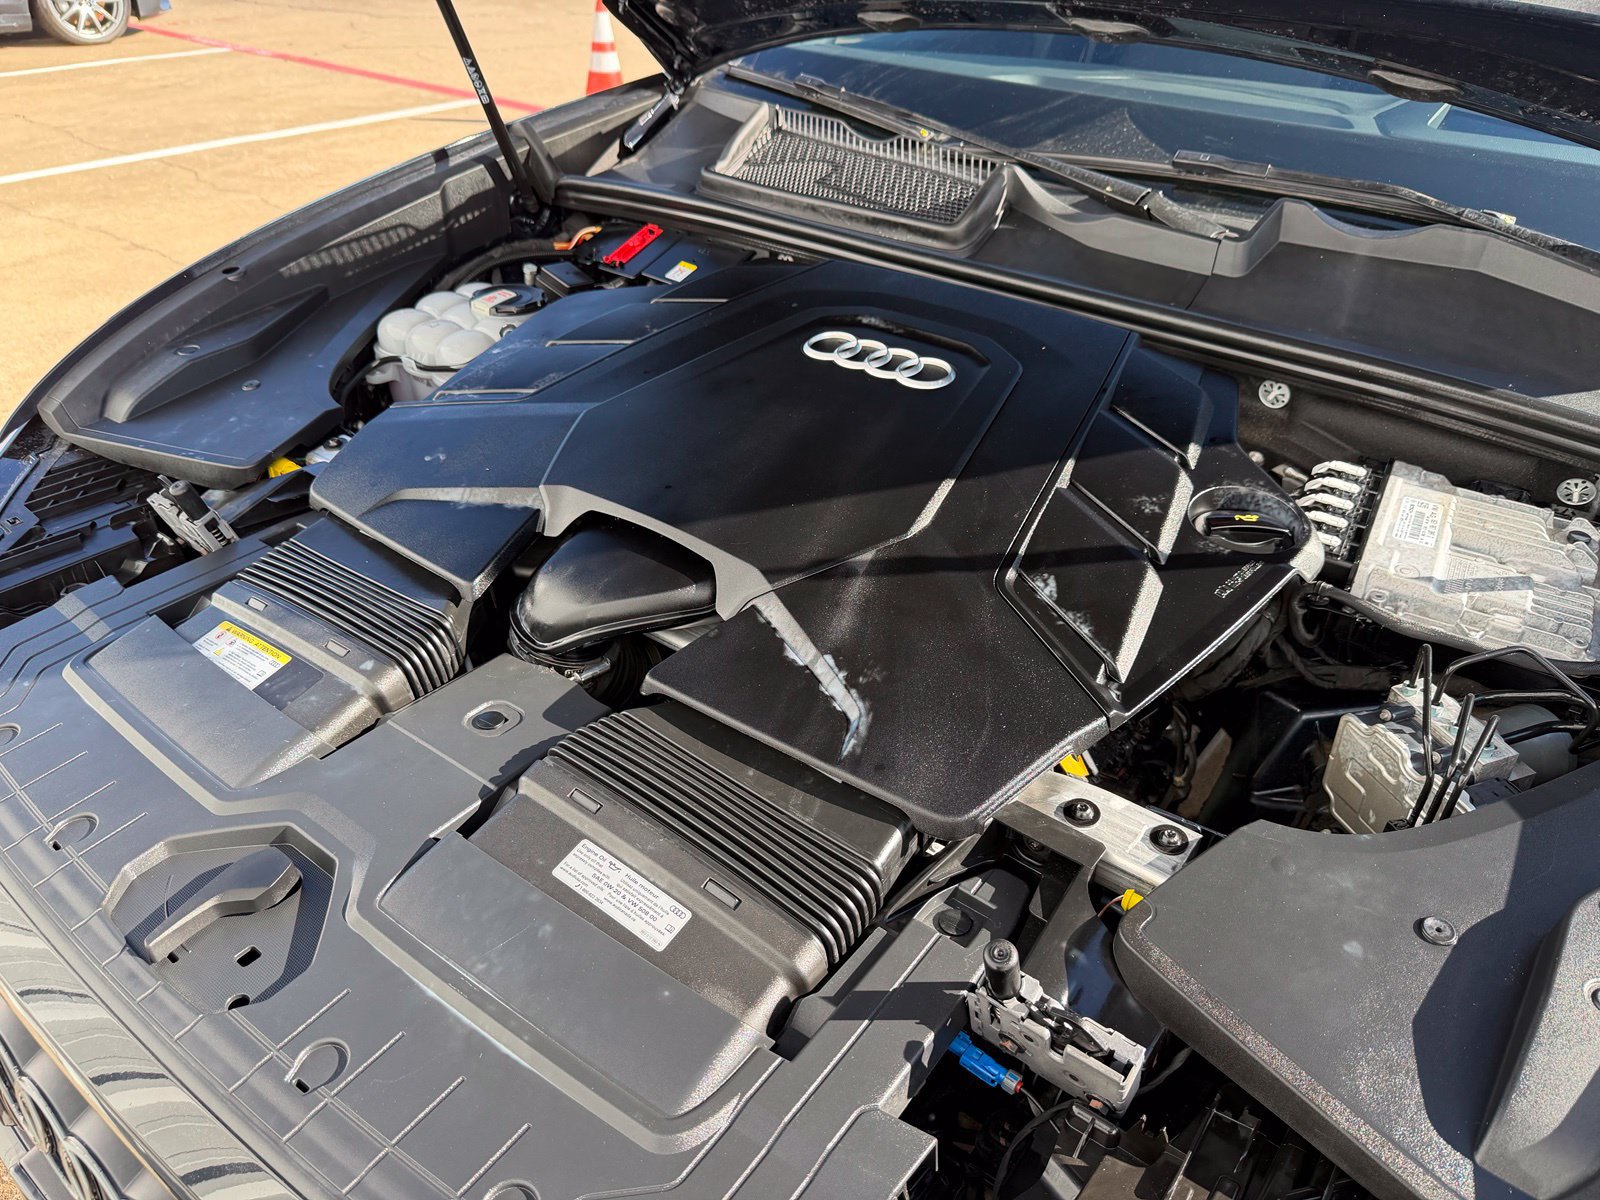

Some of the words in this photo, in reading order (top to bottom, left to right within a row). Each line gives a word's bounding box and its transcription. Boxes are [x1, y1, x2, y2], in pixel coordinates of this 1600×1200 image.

[232, 630, 254, 642] WARNING
[254, 642, 281, 658] ATTENTION
[581, 843, 598, 856] Engine
[591, 873, 603, 882] SAE
[603, 881, 621, 895] 0W-20
[627, 898, 638, 907] VW
[638, 906, 649, 915] 508
[625, 873, 638, 883] Huile
[638, 883, 658, 898] moteur
